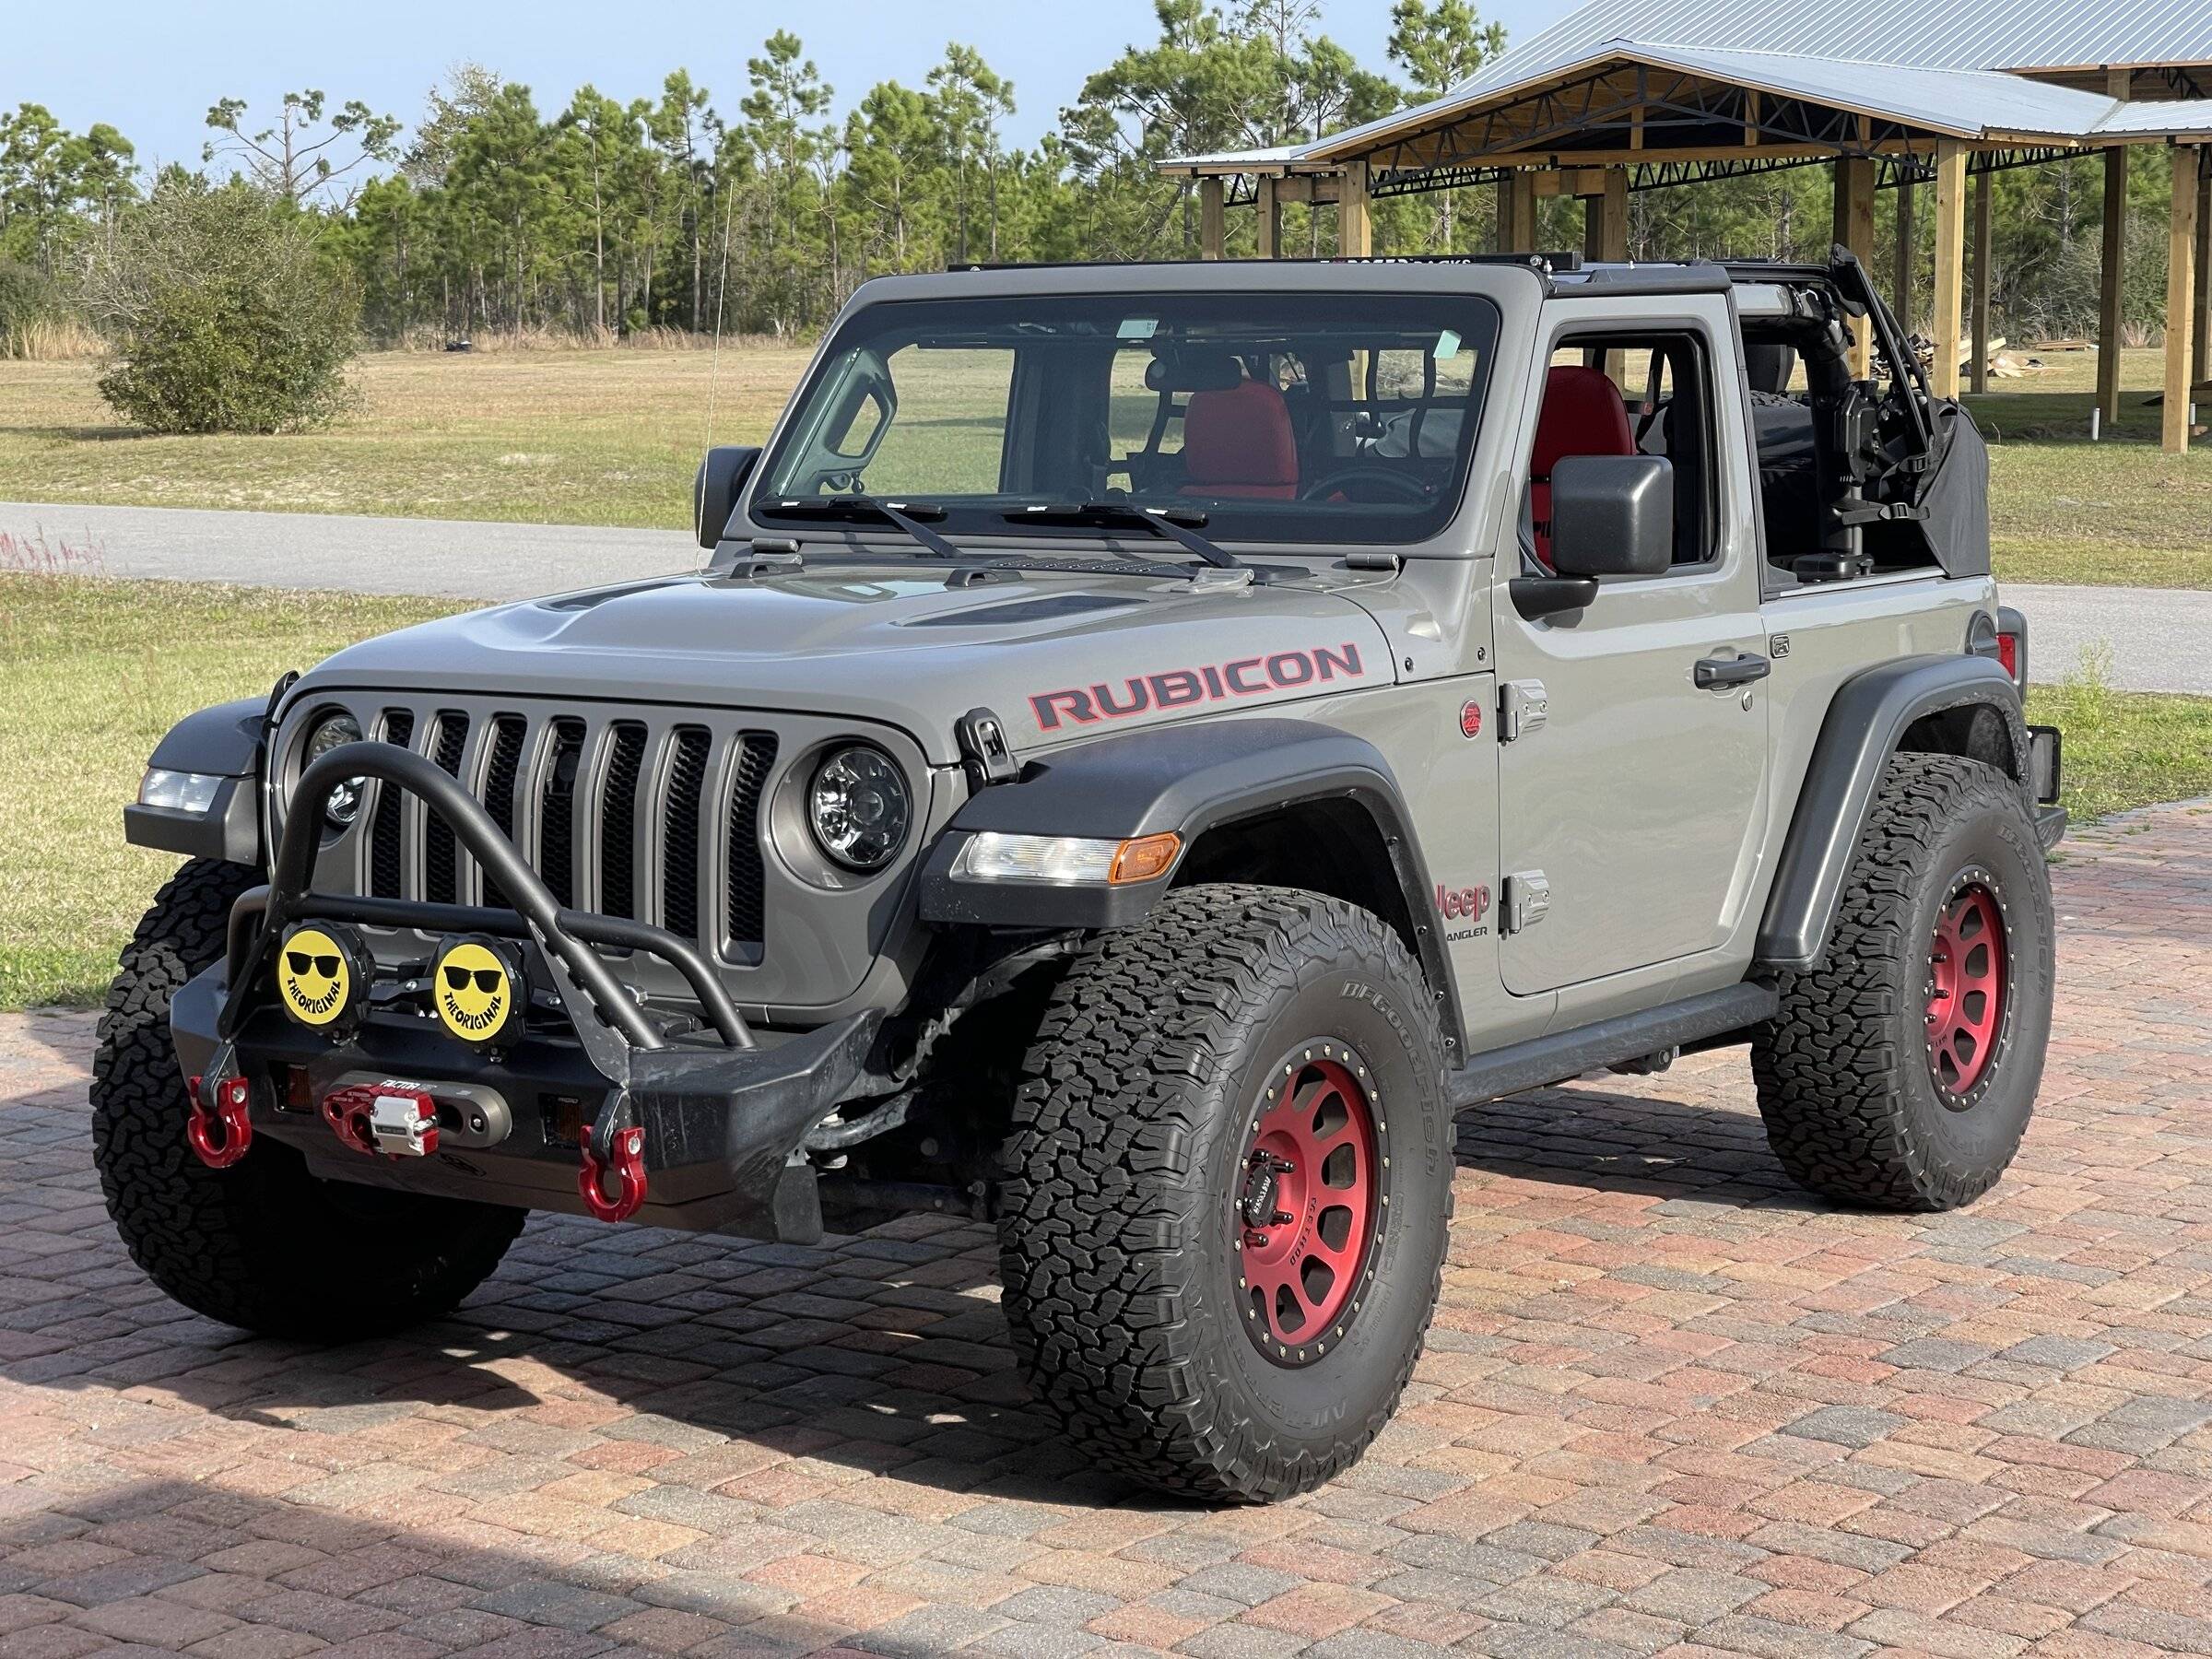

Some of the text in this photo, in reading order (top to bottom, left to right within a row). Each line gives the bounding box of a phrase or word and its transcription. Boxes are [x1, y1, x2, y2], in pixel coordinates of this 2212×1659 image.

[1028, 644, 1364, 731] RUBICON
[1435, 884, 1490, 923] Jeep
[1446, 926, 1488, 941] ANGLER
